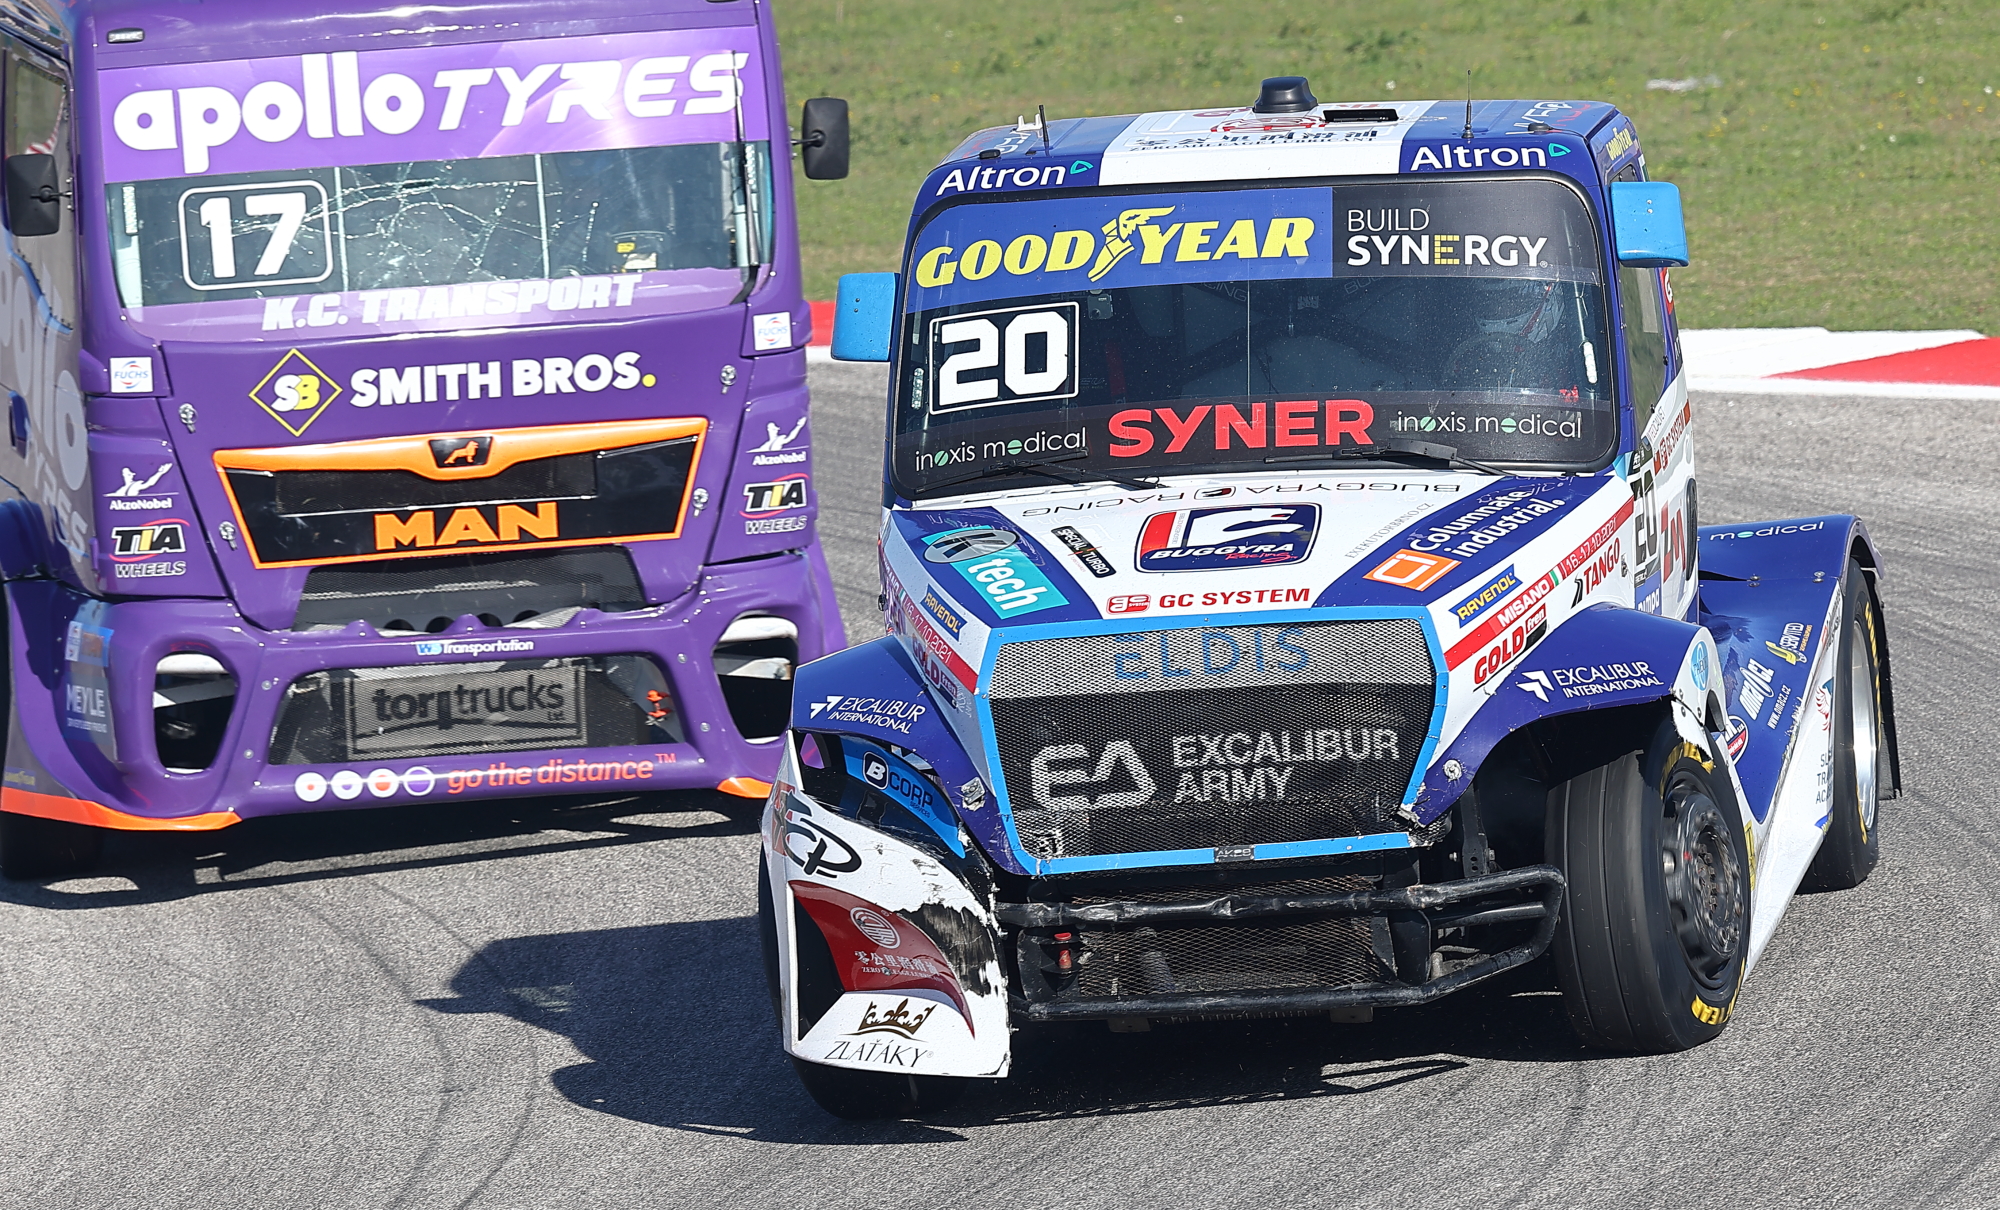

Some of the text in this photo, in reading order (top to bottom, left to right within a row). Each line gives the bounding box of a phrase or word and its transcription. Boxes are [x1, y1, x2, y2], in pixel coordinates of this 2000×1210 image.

[113, 51, 750, 174] apollo TYRES
[1410, 144, 1546, 172] Altron
[936, 165, 1066, 196] Altron
[199, 192, 307, 279] 17
[1347, 208, 1430, 232] BUILD
[1347, 234, 1547, 267] SYNERGY
[262, 275, 643, 332] K.C. TRANSPORT
[757, 325, 788, 337] FUCHS
[113, 369, 149, 381] FUCHS
[939, 311, 1069, 407] 20
[350, 350, 657, 408] SMITH BROS.
[1108, 400, 1375, 458] SYNER
[752, 451, 807, 466] AkzoNobel
[109, 497, 173, 511] AkzoNobel
[1023, 482, 1462, 517] BUGGYRA RACING
[374, 501, 559, 551] MAN
[744, 515, 807, 535] WHEELS
[1409, 490, 1534, 552] Columnate
[1709, 520, 1825, 542] medical
[1083, 551, 1110, 575] TURBO
[1149, 542, 1294, 560] BUGGYRA
[1583, 537, 1620, 595] TANGO
[114, 560, 187, 578] WHEELS
[967, 557, 1049, 611] tech
[924, 591, 962, 634] RAVENOL
[1159, 588, 1311, 608] GC SYSTEM
[1456, 572, 1517, 621] RAVENOL
[1496, 578, 1550, 628] MISANO
[443, 640, 534, 657] Transportation
[911, 631, 941, 689] GOLD
[1115, 627, 1311, 680] ELDIS
[1474, 625, 1525, 685] GOLD
[1552, 661, 1655, 686] EXCALIBUR
[1562, 677, 1664, 699] INTERNATIONAL
[828, 710, 914, 735] INTERNATIONAL
[838, 697, 926, 723] EXCALIBUR
[1173, 728, 1399, 768] EXCALIBUR
[446, 767, 484, 795] go
[487, 761, 536, 788] the
[536, 755, 654, 785] distance
[1174, 767, 1294, 803] ARMY
[823, 1039, 929, 1068] ZLAŤÁKY
